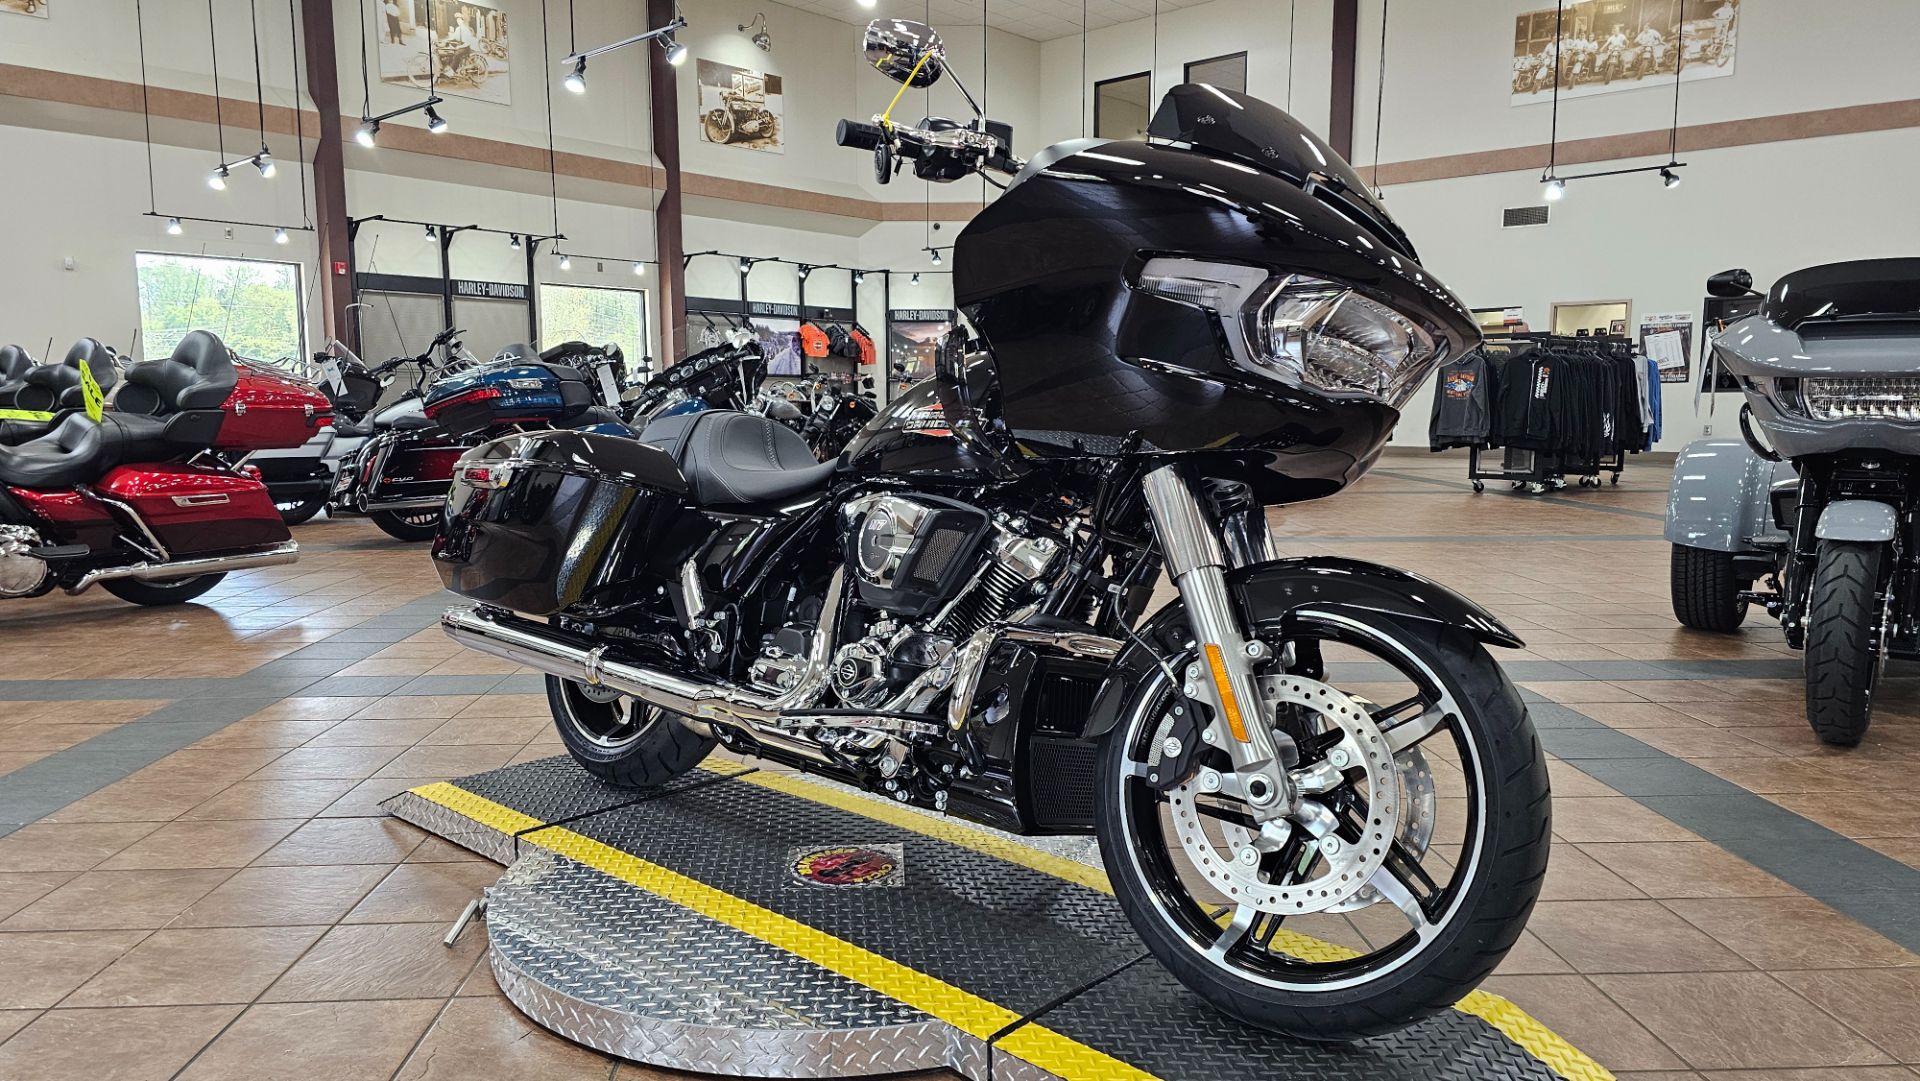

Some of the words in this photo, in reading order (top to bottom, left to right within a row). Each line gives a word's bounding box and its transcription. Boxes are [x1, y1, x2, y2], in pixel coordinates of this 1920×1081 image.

[458, 281, 524, 298] HARLEY-DAVIDSON
[753, 303, 798, 316] HARLEY-DAVIDSON
[894, 310, 949, 321] HARLEY-DAVIDSON
[911, 410, 946, 420] HARL
